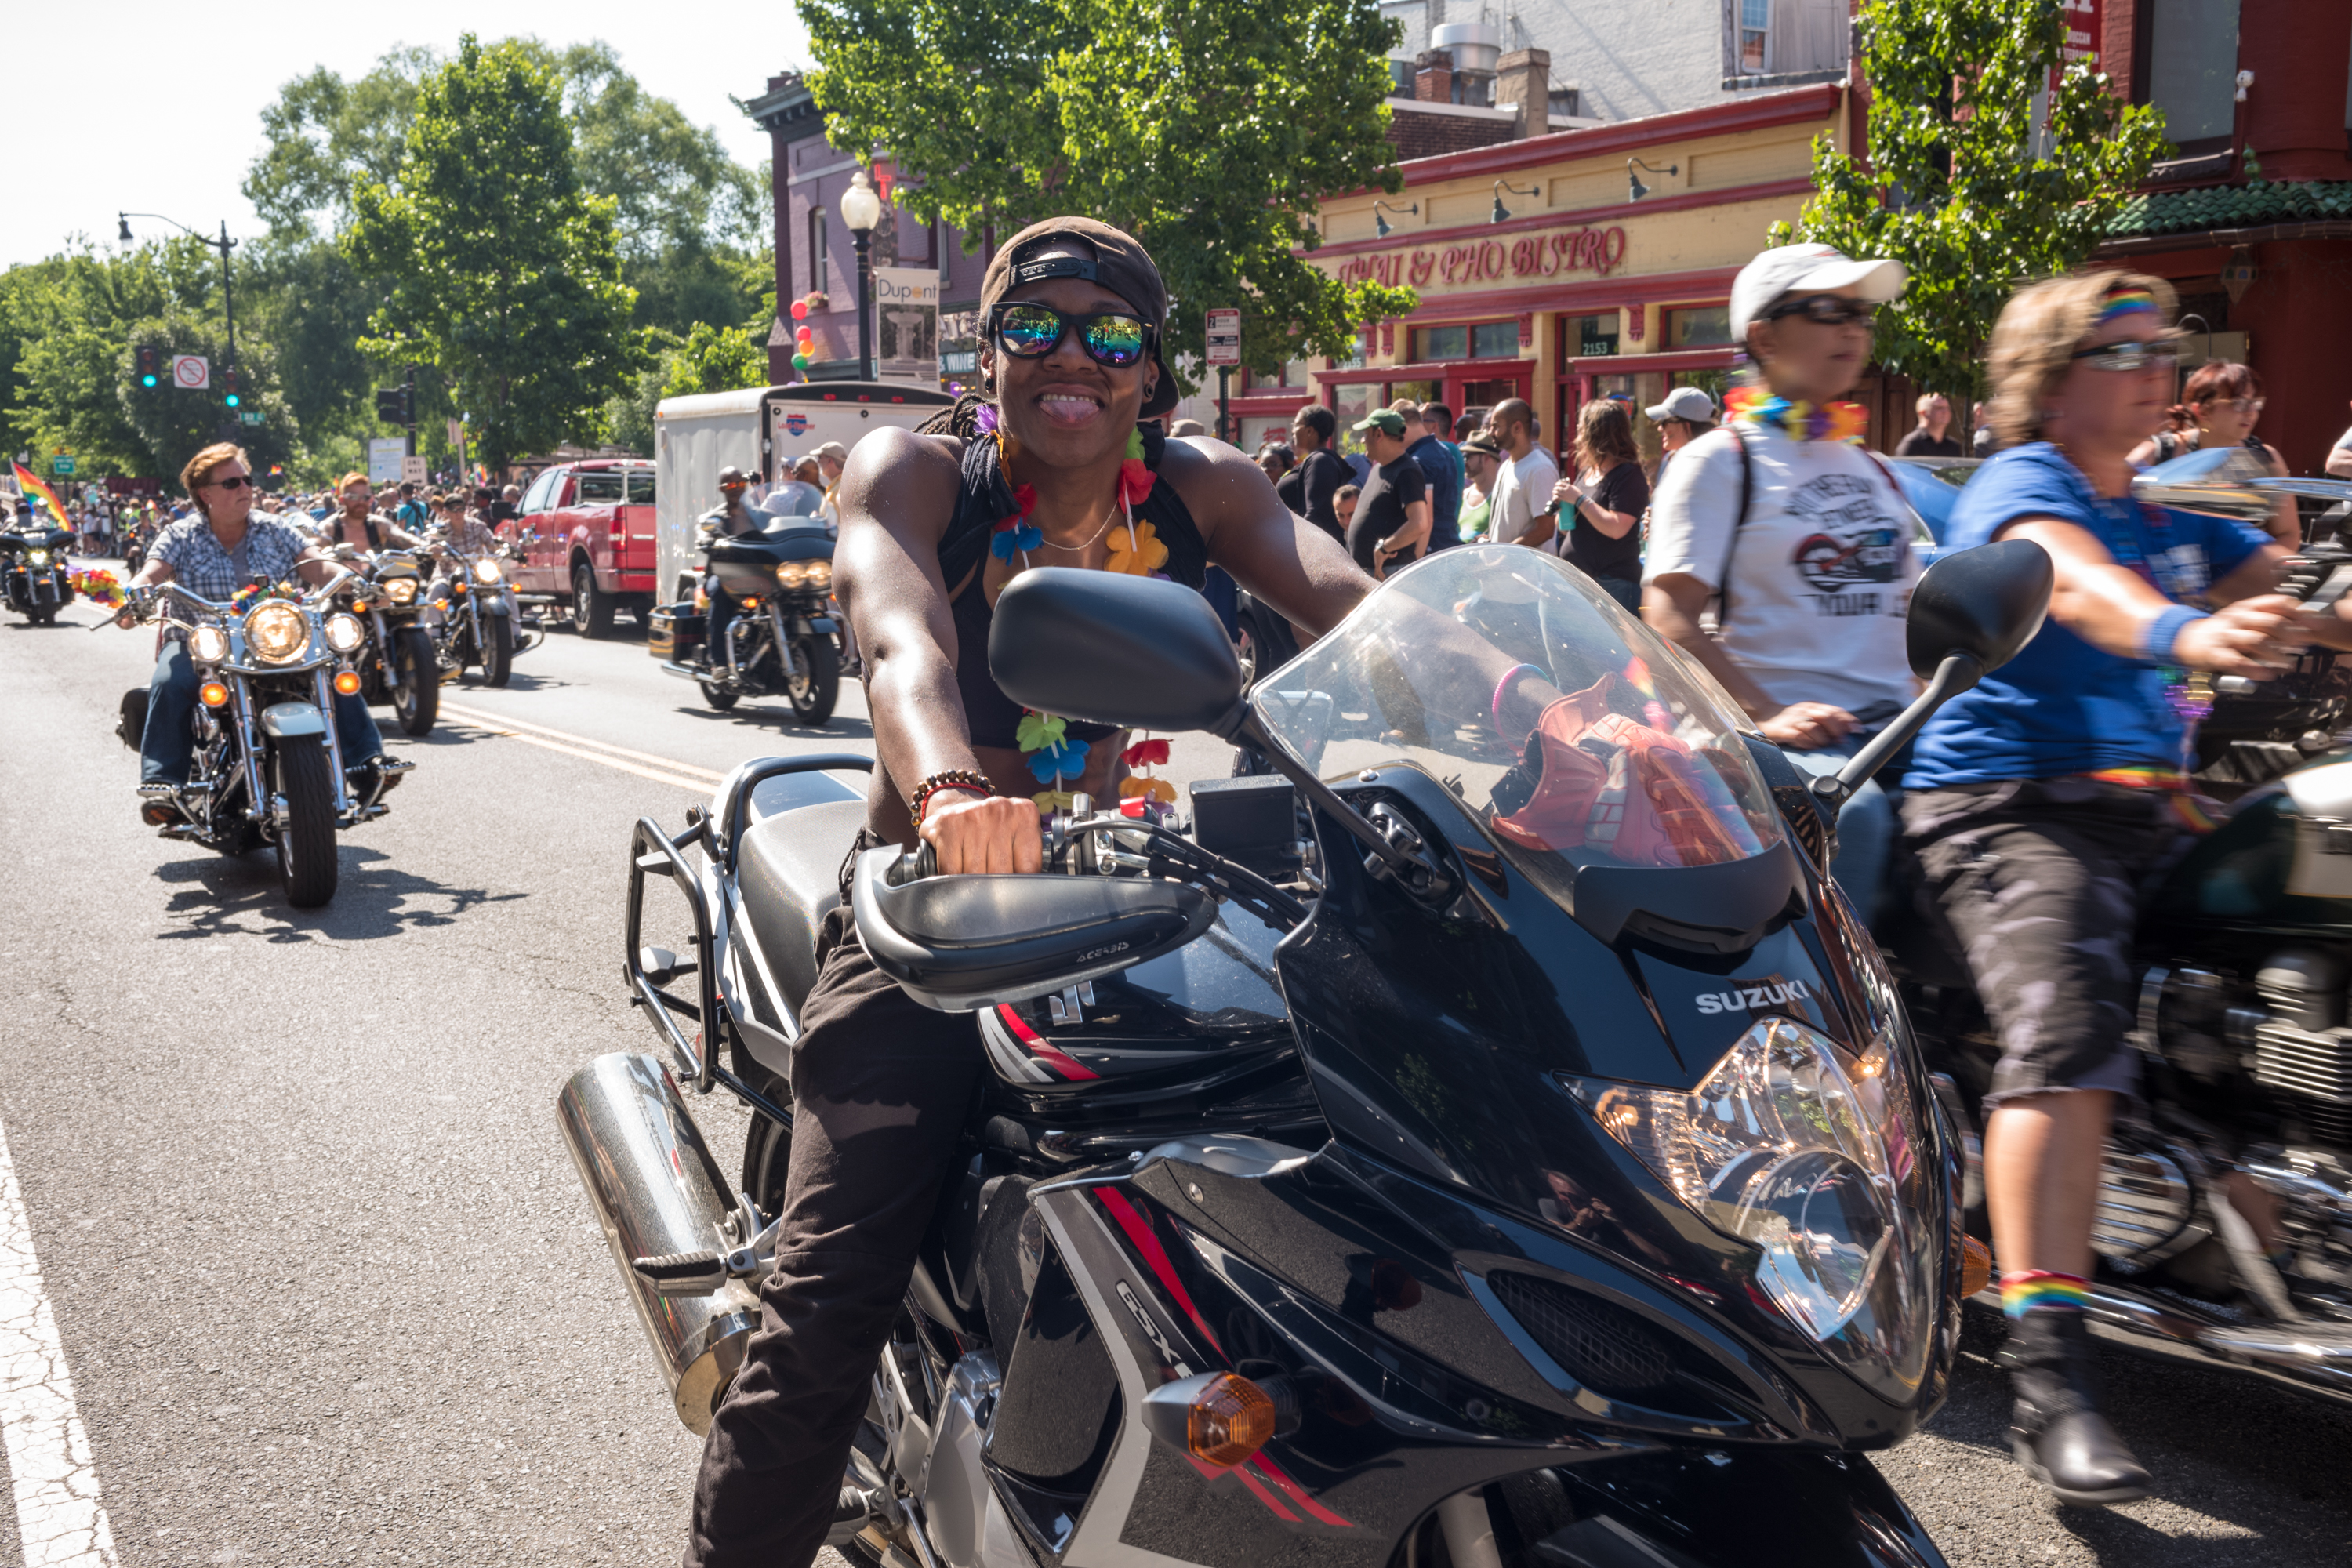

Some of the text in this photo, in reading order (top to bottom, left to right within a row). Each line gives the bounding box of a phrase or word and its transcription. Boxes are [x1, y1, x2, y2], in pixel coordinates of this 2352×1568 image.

[1338, 227, 1625, 287] THAI & PHO BISTRO
[946, 352, 975, 372] WINE
[1583, 342, 1608, 356] 2153
[1694, 979, 1810, 1014] SUZUKI
